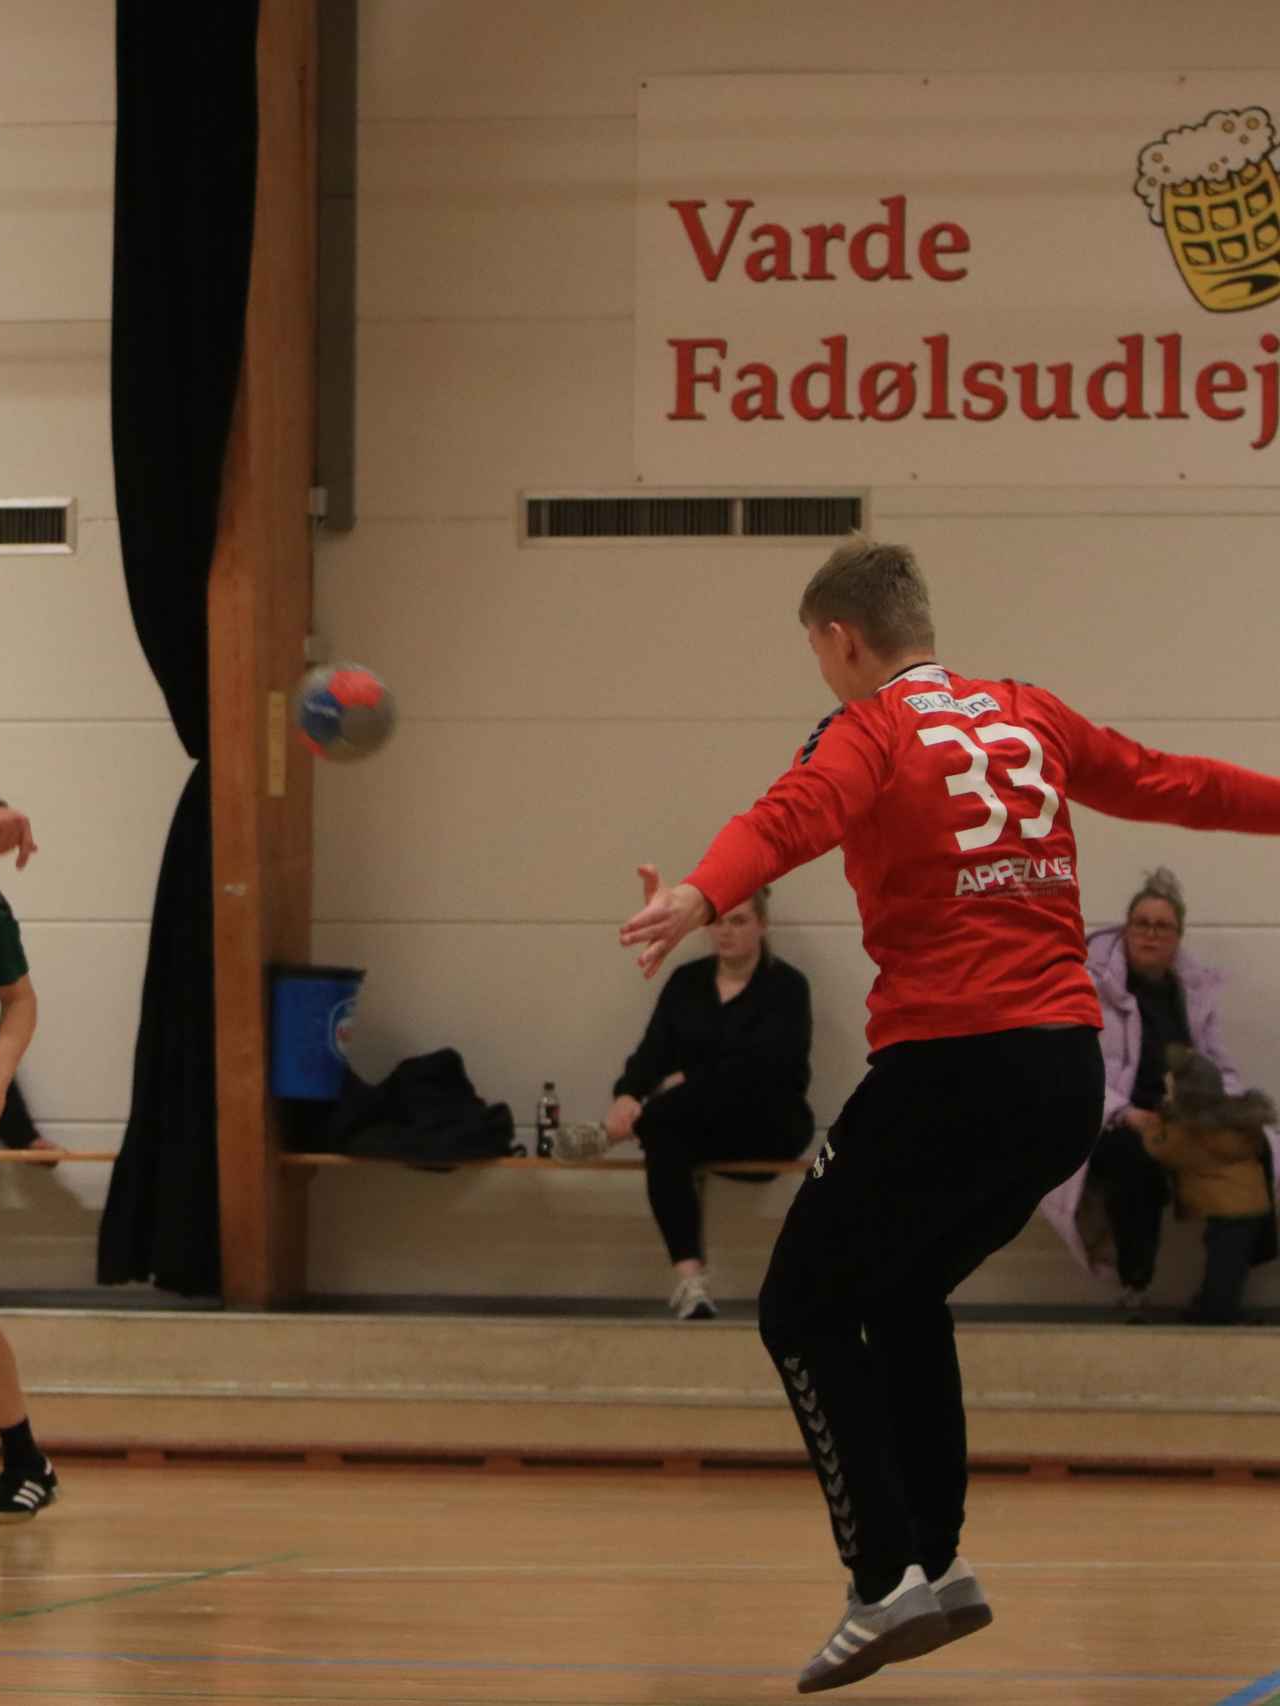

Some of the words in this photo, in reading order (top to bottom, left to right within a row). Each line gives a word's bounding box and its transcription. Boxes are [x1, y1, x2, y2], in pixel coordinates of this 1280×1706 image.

[667, 194, 972, 284] Varde
[666, 332, 1280, 450] Fadølsudlej
[916, 722, 1060, 852] 33
